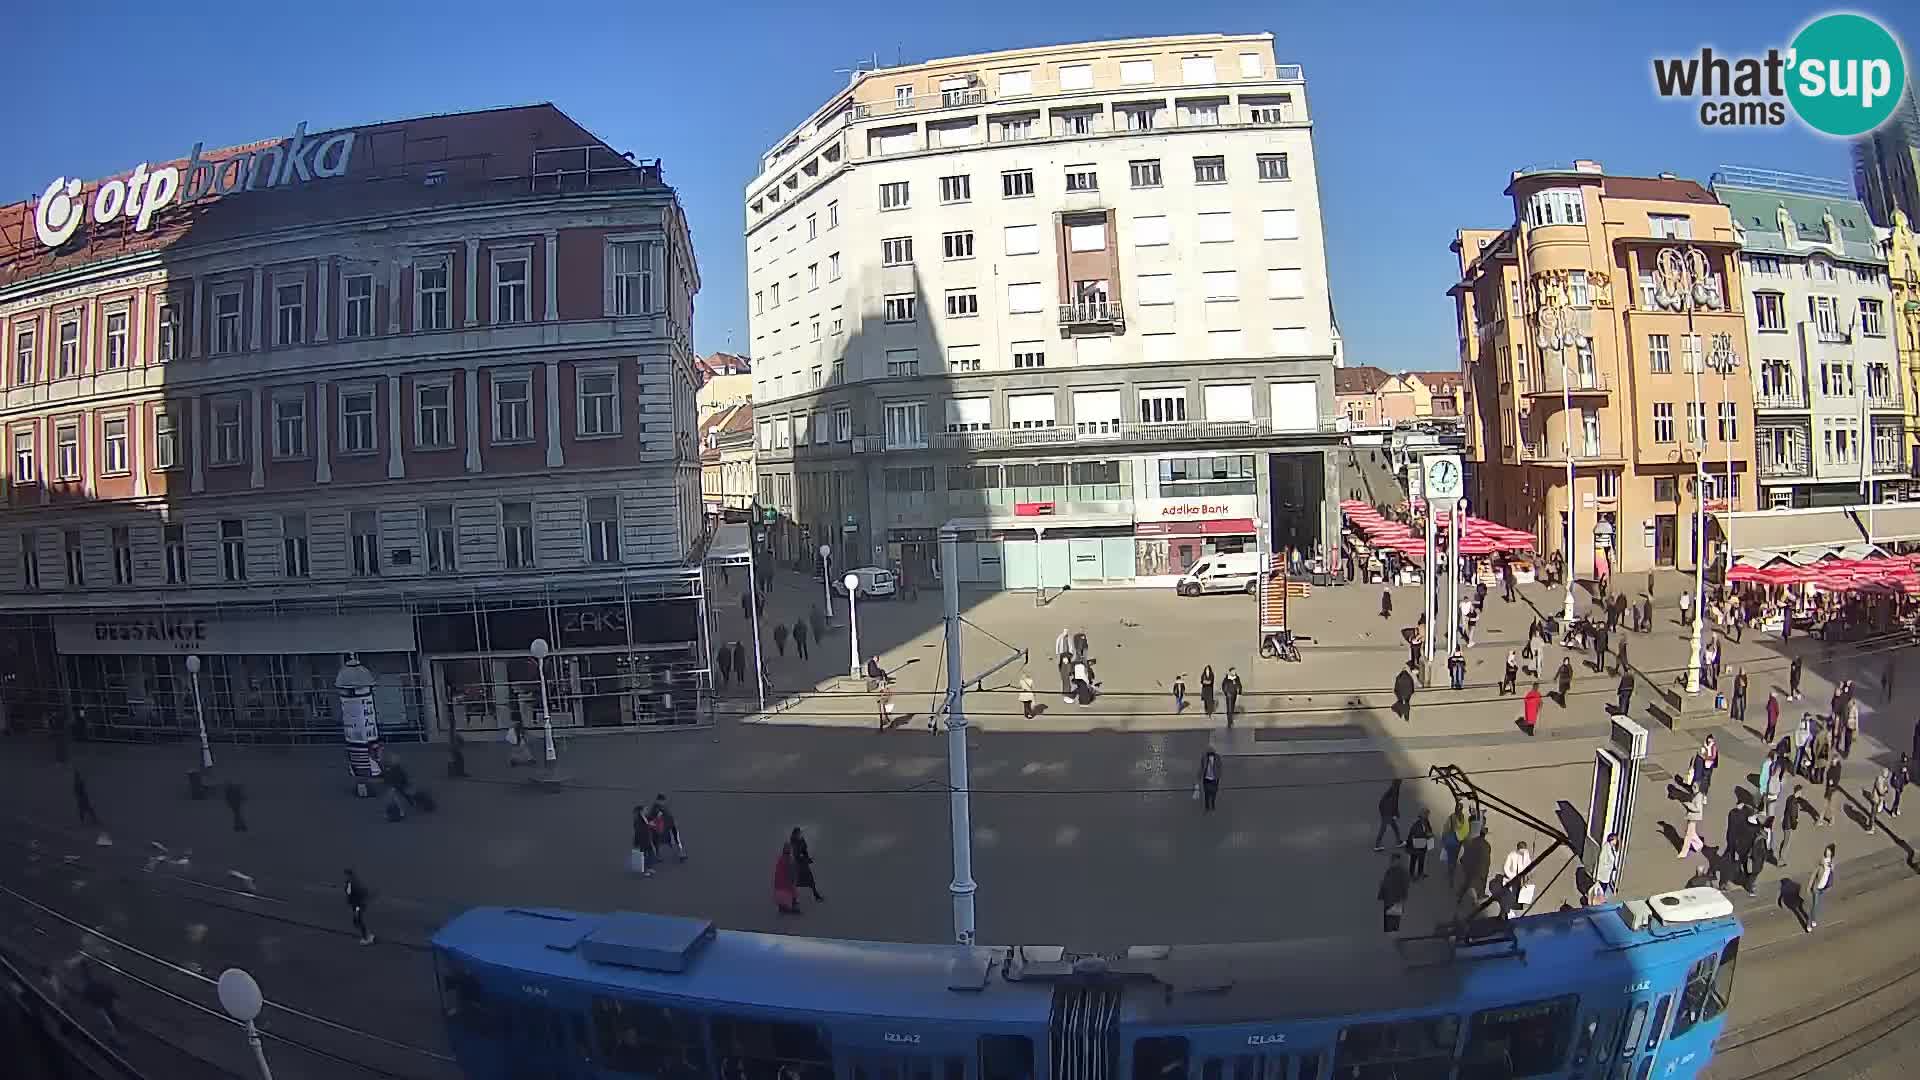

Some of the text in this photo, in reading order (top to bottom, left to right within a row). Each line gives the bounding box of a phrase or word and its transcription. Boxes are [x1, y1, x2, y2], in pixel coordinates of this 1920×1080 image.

[94, 120, 356, 232] otp banka
[1162, 503, 1229, 516] Addiko Bank
[1247, 1034, 1287, 1045] IZLAZ
